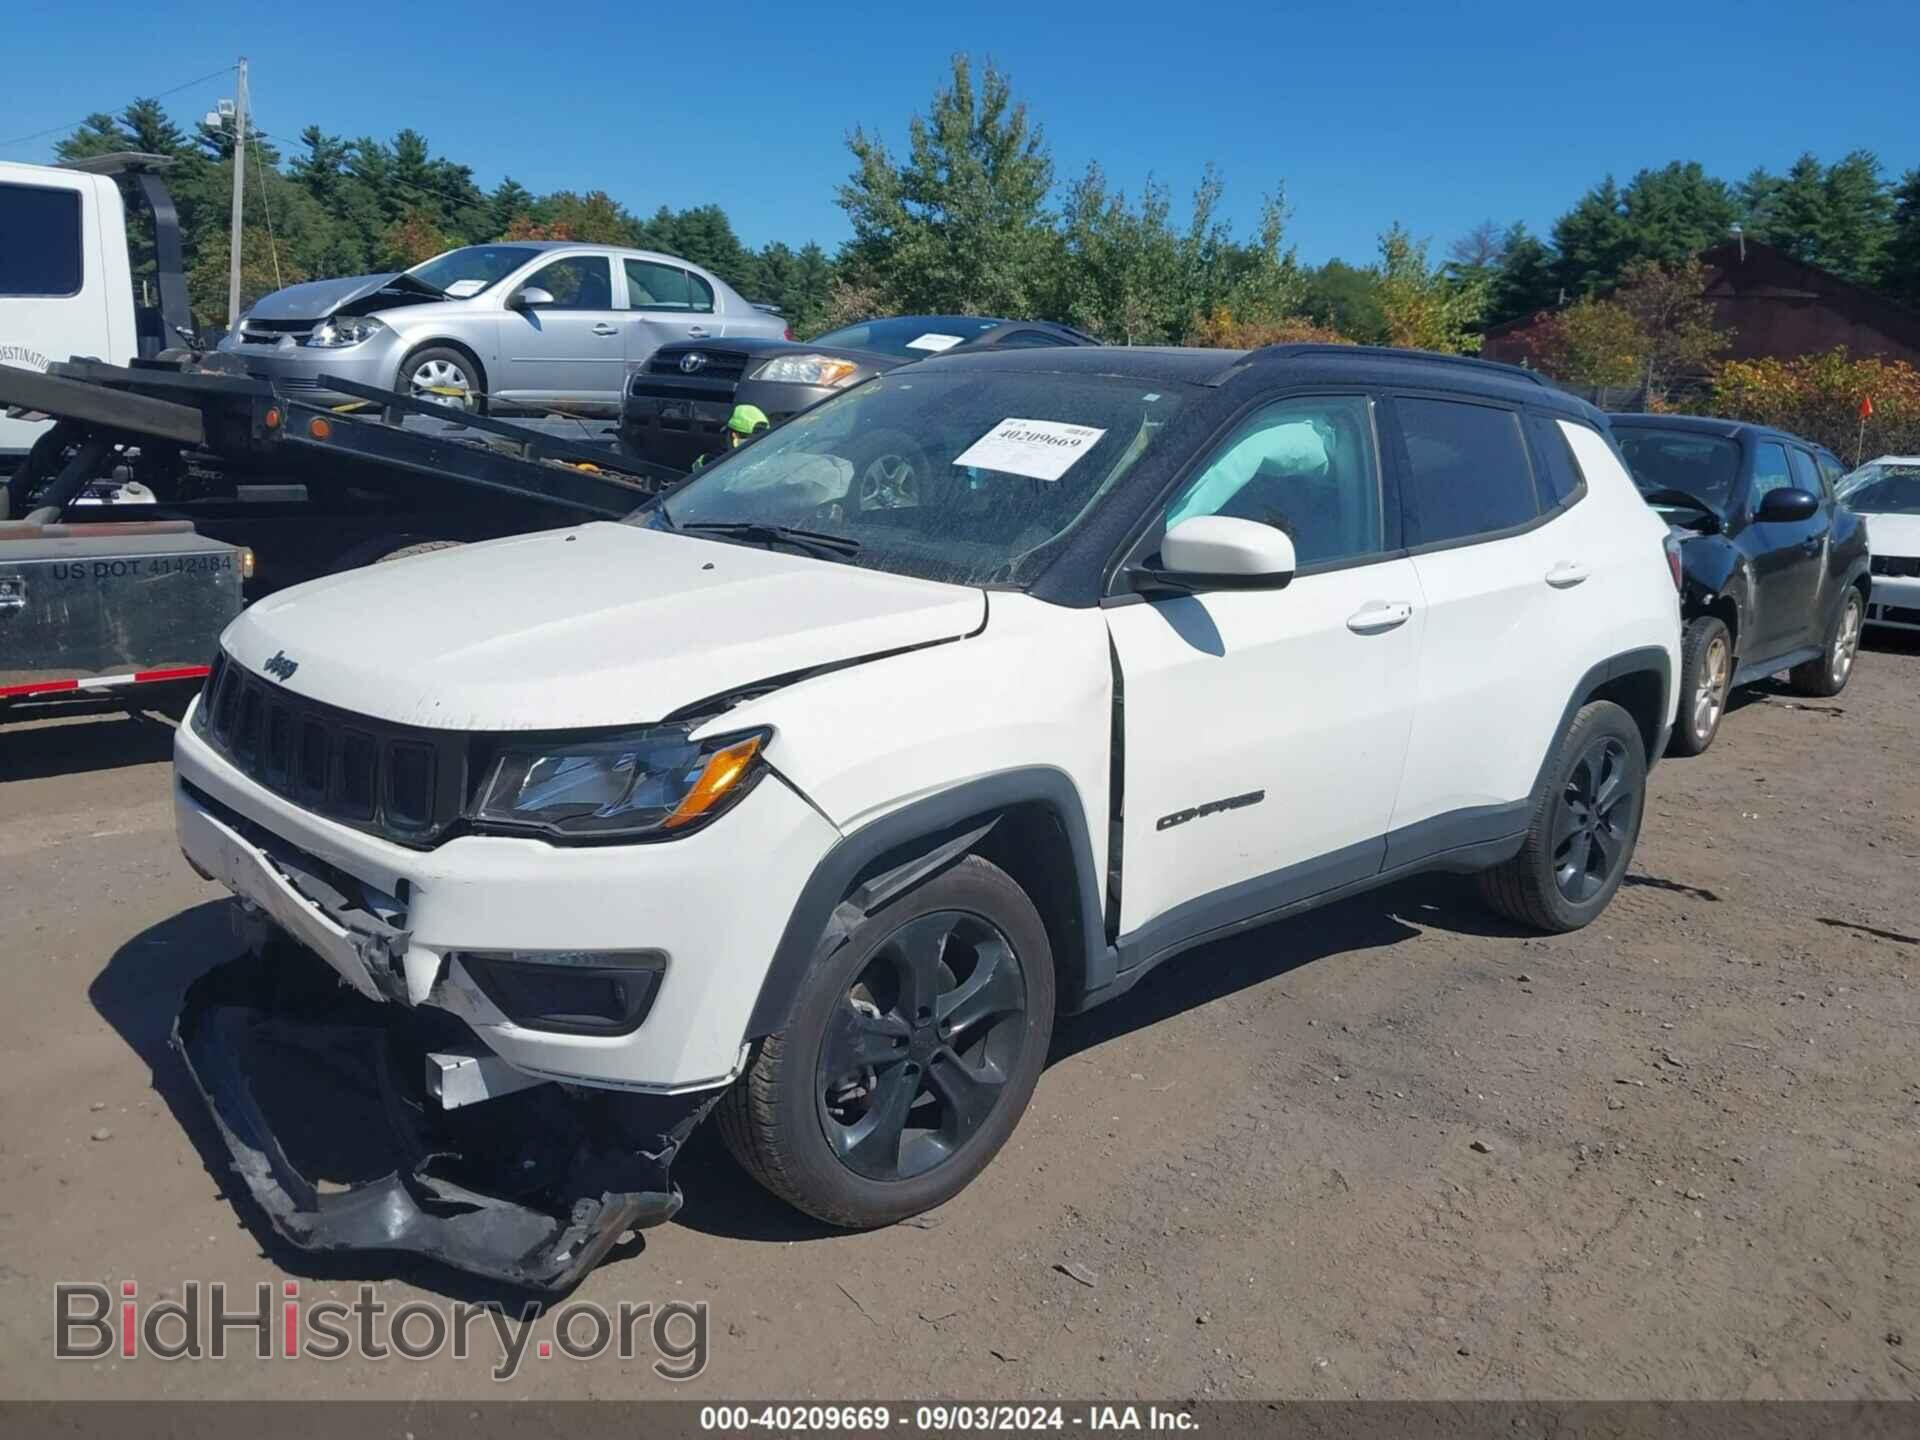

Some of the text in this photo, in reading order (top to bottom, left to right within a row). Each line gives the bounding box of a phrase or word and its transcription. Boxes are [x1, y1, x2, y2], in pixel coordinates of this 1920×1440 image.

[1000, 430, 1082, 447] 40209669
[53, 556, 231, 580] US DOT 4142484
